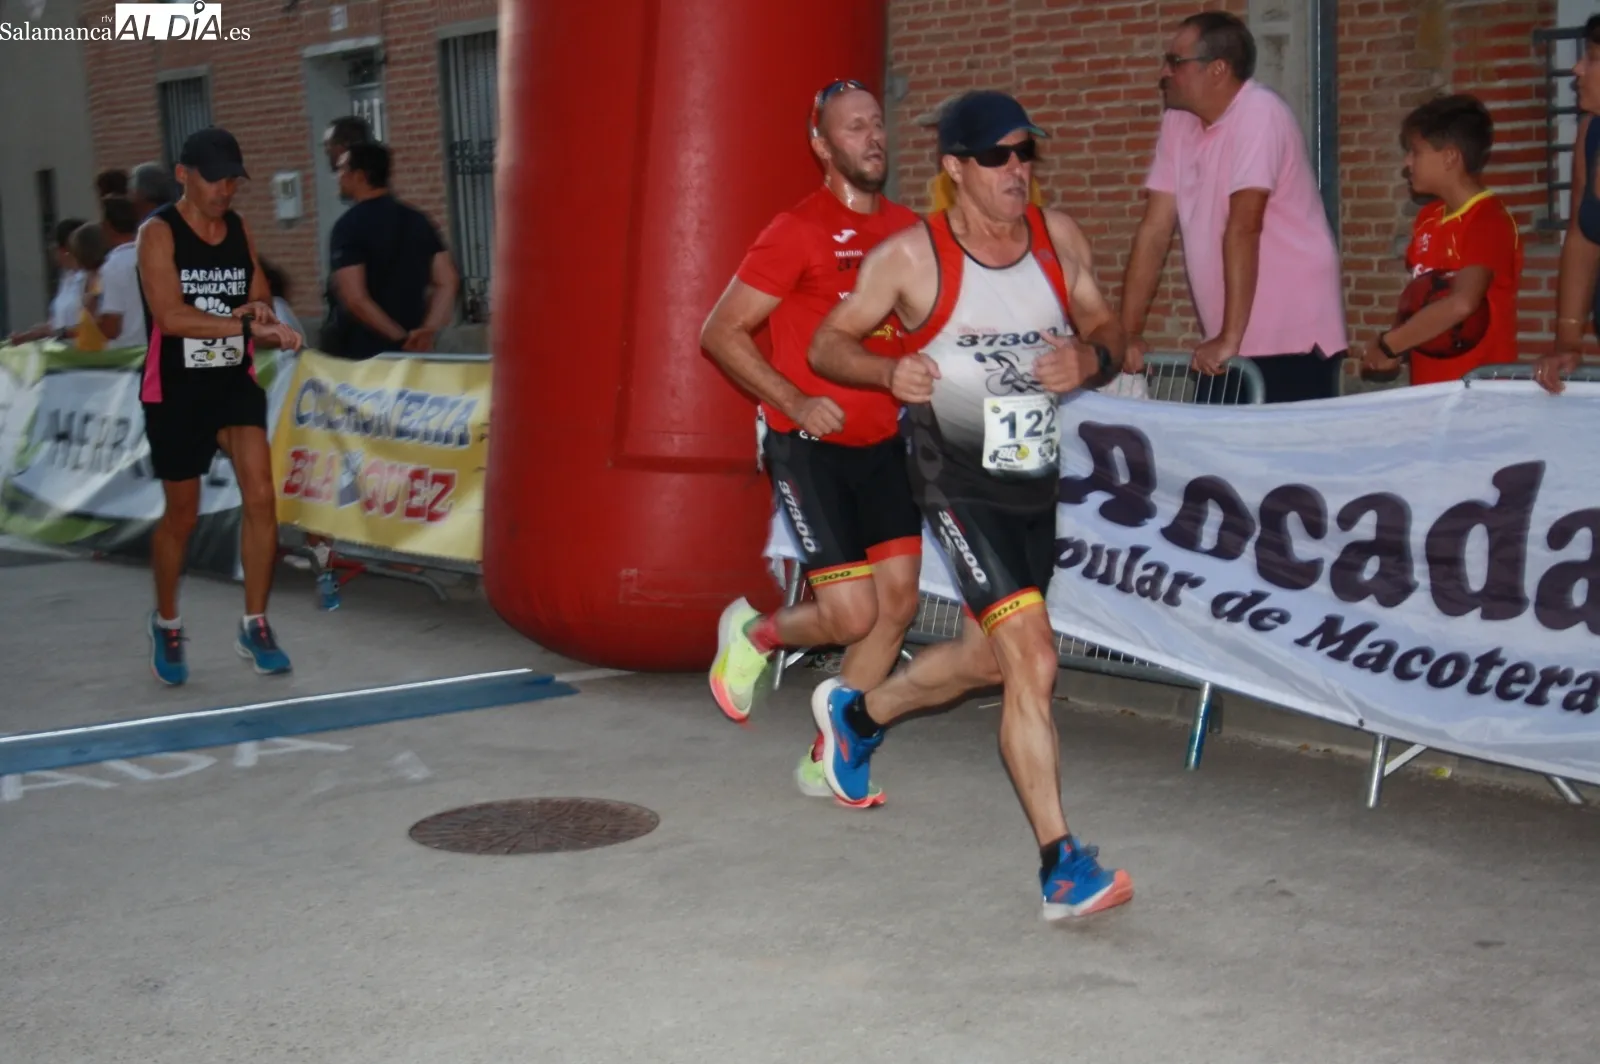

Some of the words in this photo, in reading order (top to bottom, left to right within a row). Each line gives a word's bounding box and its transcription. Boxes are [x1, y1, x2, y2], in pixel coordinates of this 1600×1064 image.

[999, 406, 1057, 439] 122
[777, 479, 815, 553] 37300
[938, 510, 987, 585] 37300
[1210, 589, 1292, 632] de
[1296, 614, 1600, 716] Macotera
